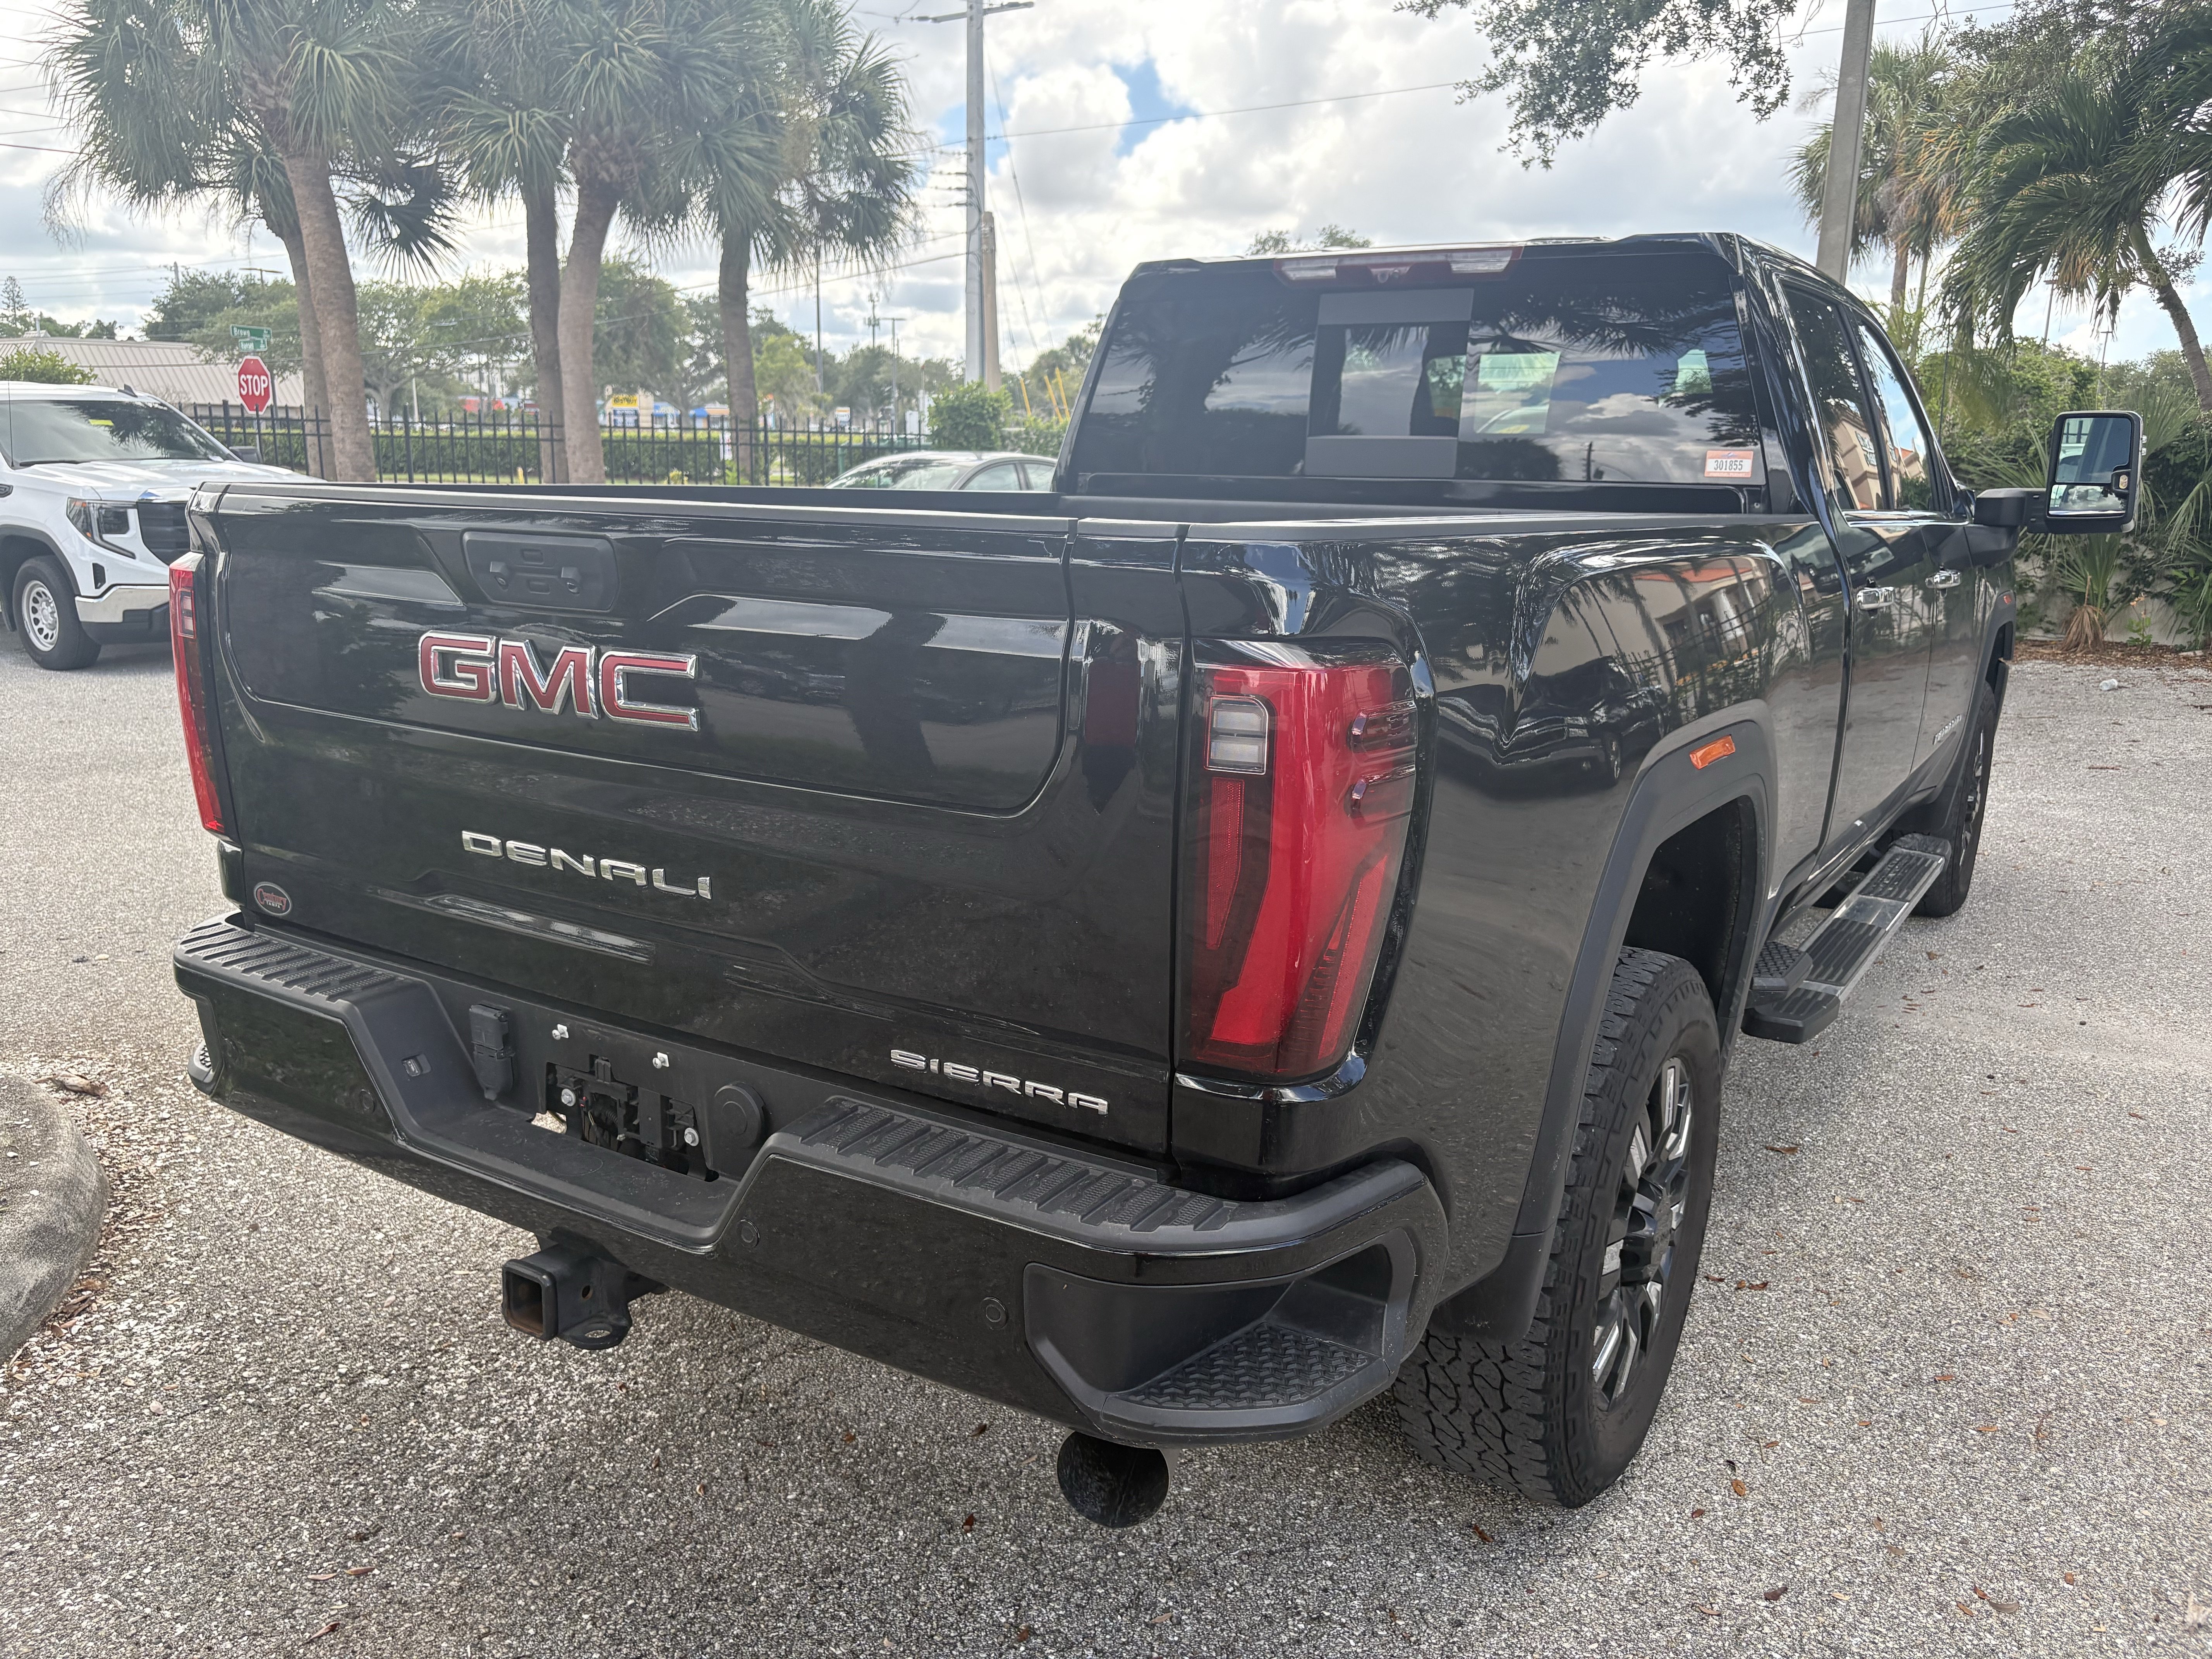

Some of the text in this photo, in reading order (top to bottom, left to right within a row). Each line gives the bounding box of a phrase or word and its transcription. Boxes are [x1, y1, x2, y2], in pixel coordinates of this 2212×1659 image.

[240, 374, 268, 396] STOP
[1714, 460, 1743, 471] 301855
[419, 630, 699, 732] GMC
[462, 830, 712, 900] DENALI
[891, 1049, 1109, 1115] SIERRA
